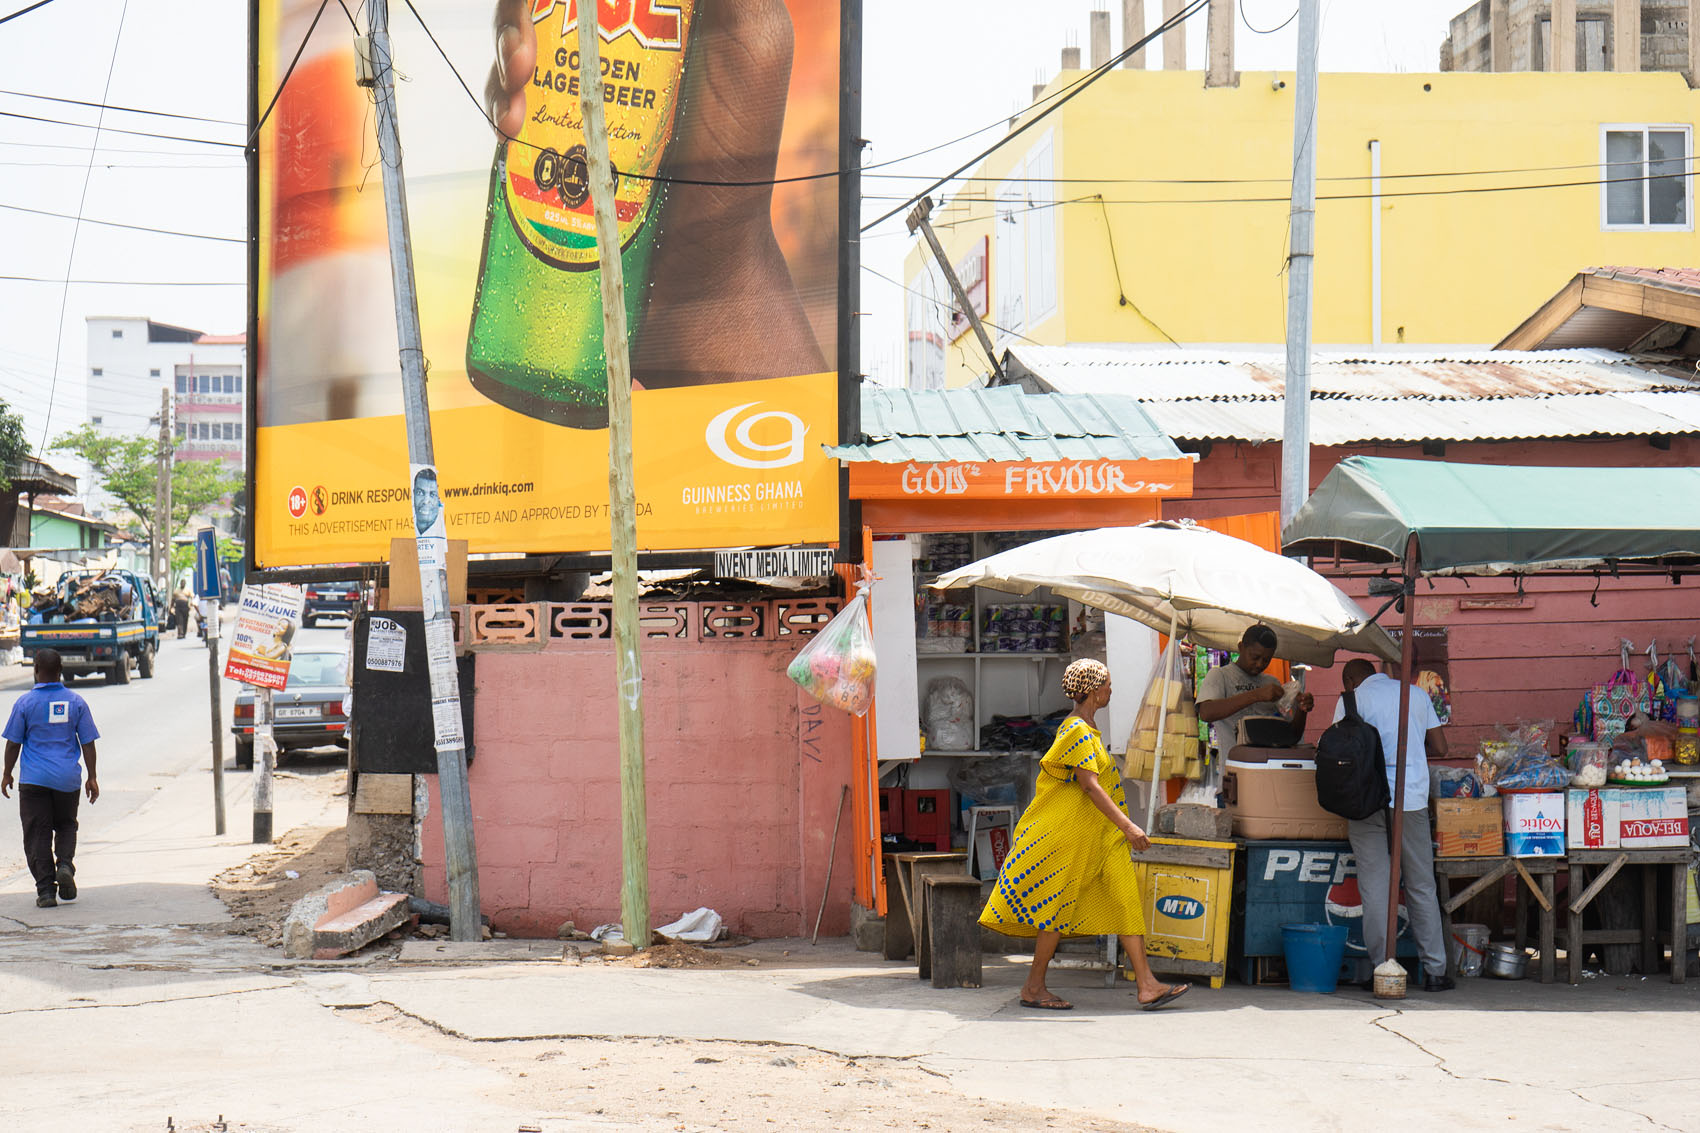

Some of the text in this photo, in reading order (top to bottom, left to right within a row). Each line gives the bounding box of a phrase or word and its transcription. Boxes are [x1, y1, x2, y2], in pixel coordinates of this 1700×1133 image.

[555, 47, 641, 82] GODEN
[533, 66, 657, 110] LAGE BEER
[532, 104, 584, 130] Limited
[1004, 461, 1145, 495] FAVOUR
[290, 480, 534, 511] 18+ DRINK RESPON www.drinkiq.com
[682, 480, 804, 505] GUINNESS GHANA
[289, 522, 310, 537] THIS
[312, 518, 393, 536] ADVERTISEMENT
[396, 516, 415, 530] HAS
[450, 510, 491, 527] VETTED
[494, 508, 518, 524] AND
[521, 505, 581, 522] APPROVED
[584, 504, 601, 518] BY
[695, 501, 804, 515] BREWERIES LIMITED
[715, 551, 834, 577] INVENT MEDIA LIMITED
[243, 598, 299, 619] MAY/JUNE
[374, 620, 398, 631] JOB
[1519, 818, 1562, 831] Voltic
[1162, 898, 1199, 917] MTN
